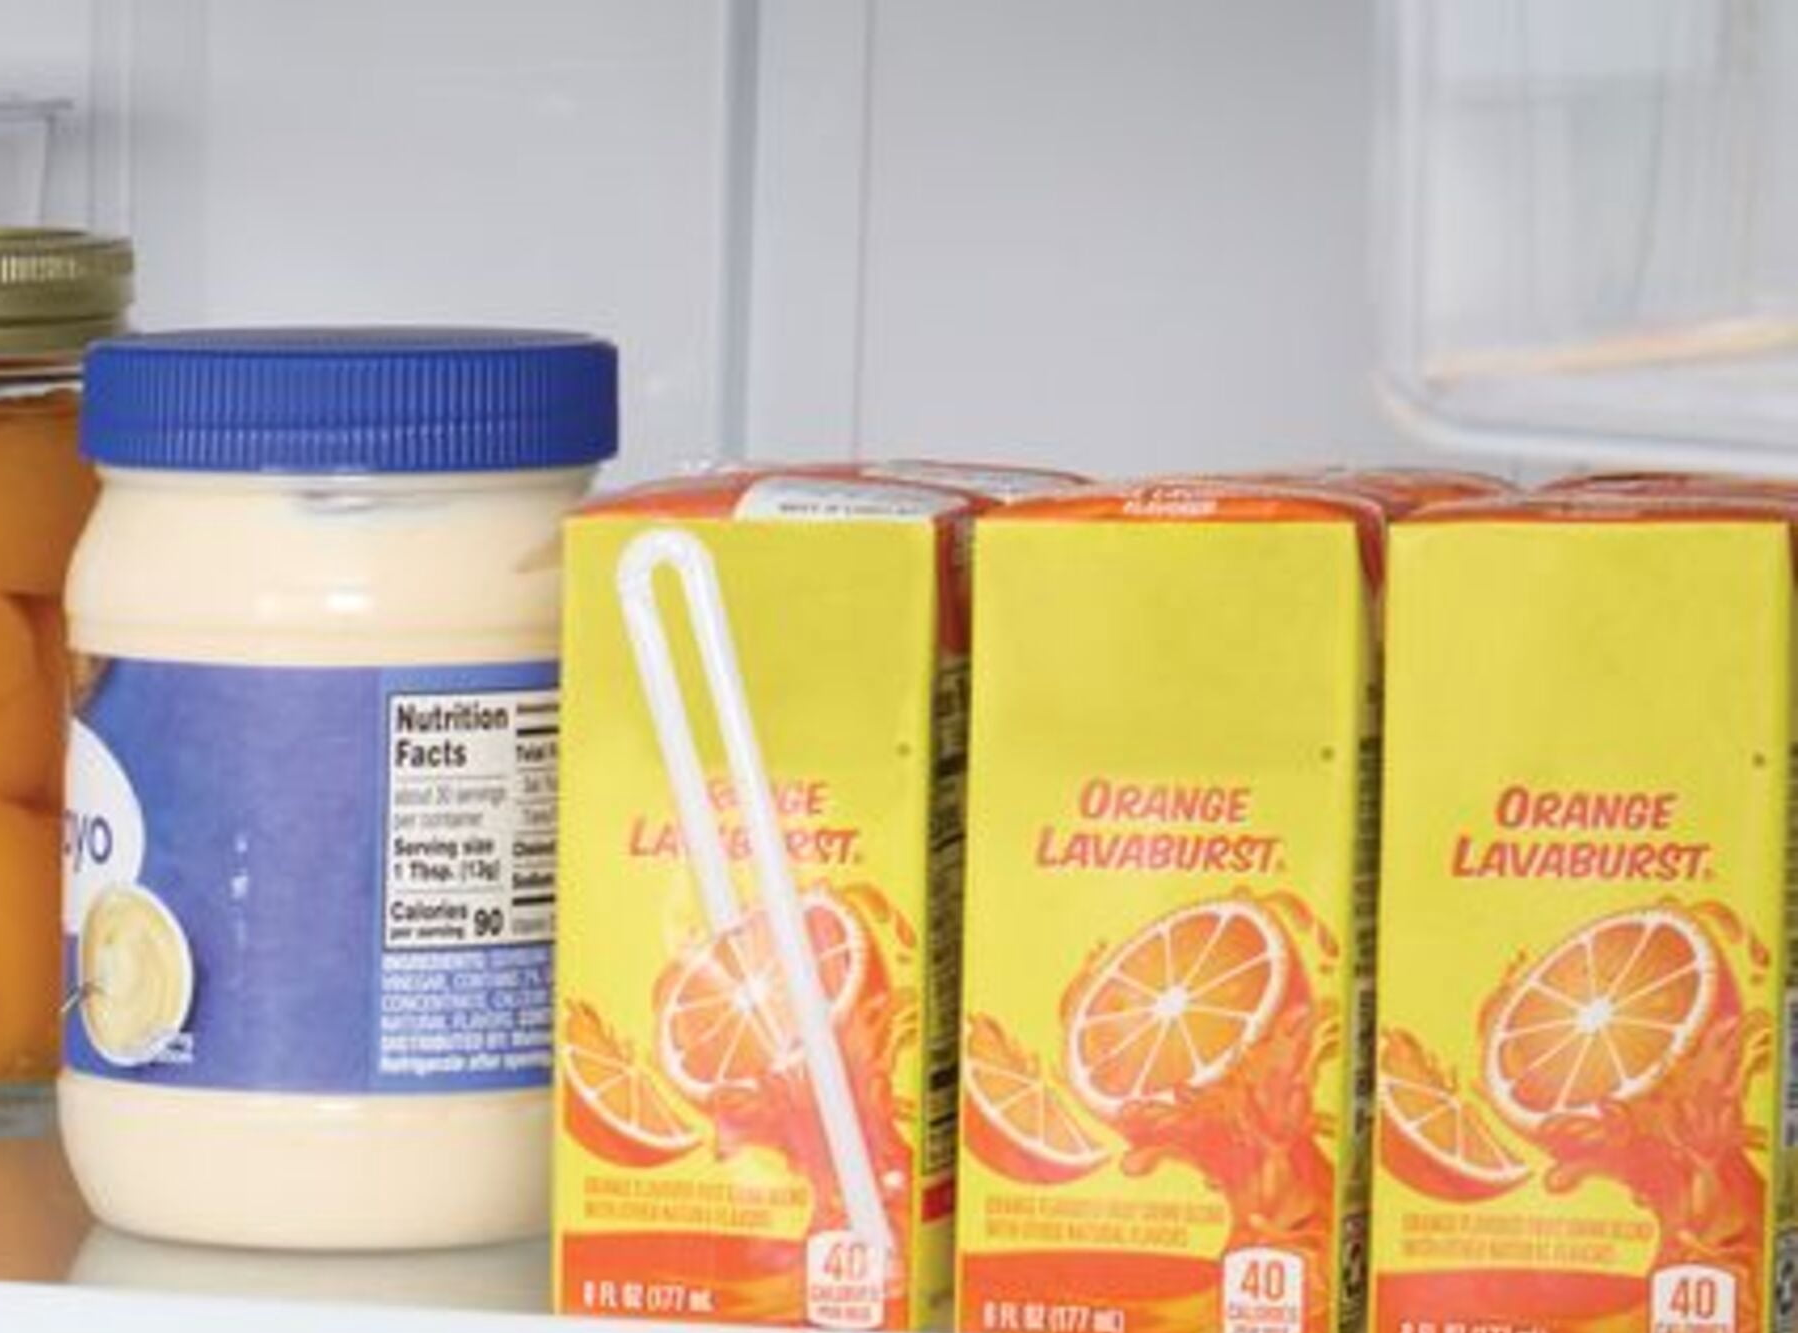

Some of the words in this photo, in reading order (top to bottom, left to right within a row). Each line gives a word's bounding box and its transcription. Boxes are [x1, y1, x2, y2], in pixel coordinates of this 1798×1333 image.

[396, 701, 508, 732] Nutrition
[395, 740, 467, 767] Facts
[1079, 777, 1252, 824] ORANGE
[1496, 784, 1679, 830] ORANGE
[395, 836, 457, 859] Serving
[463, 837, 493, 855] size
[391, 901, 468, 921] Calories
[474, 908, 504, 936] 90
[823, 1241, 867, 1281] 40
[1240, 1260, 1285, 1300] 40
[1669, 1277, 1716, 1320] 40
[1000, 1301, 1019, 1331] FL
